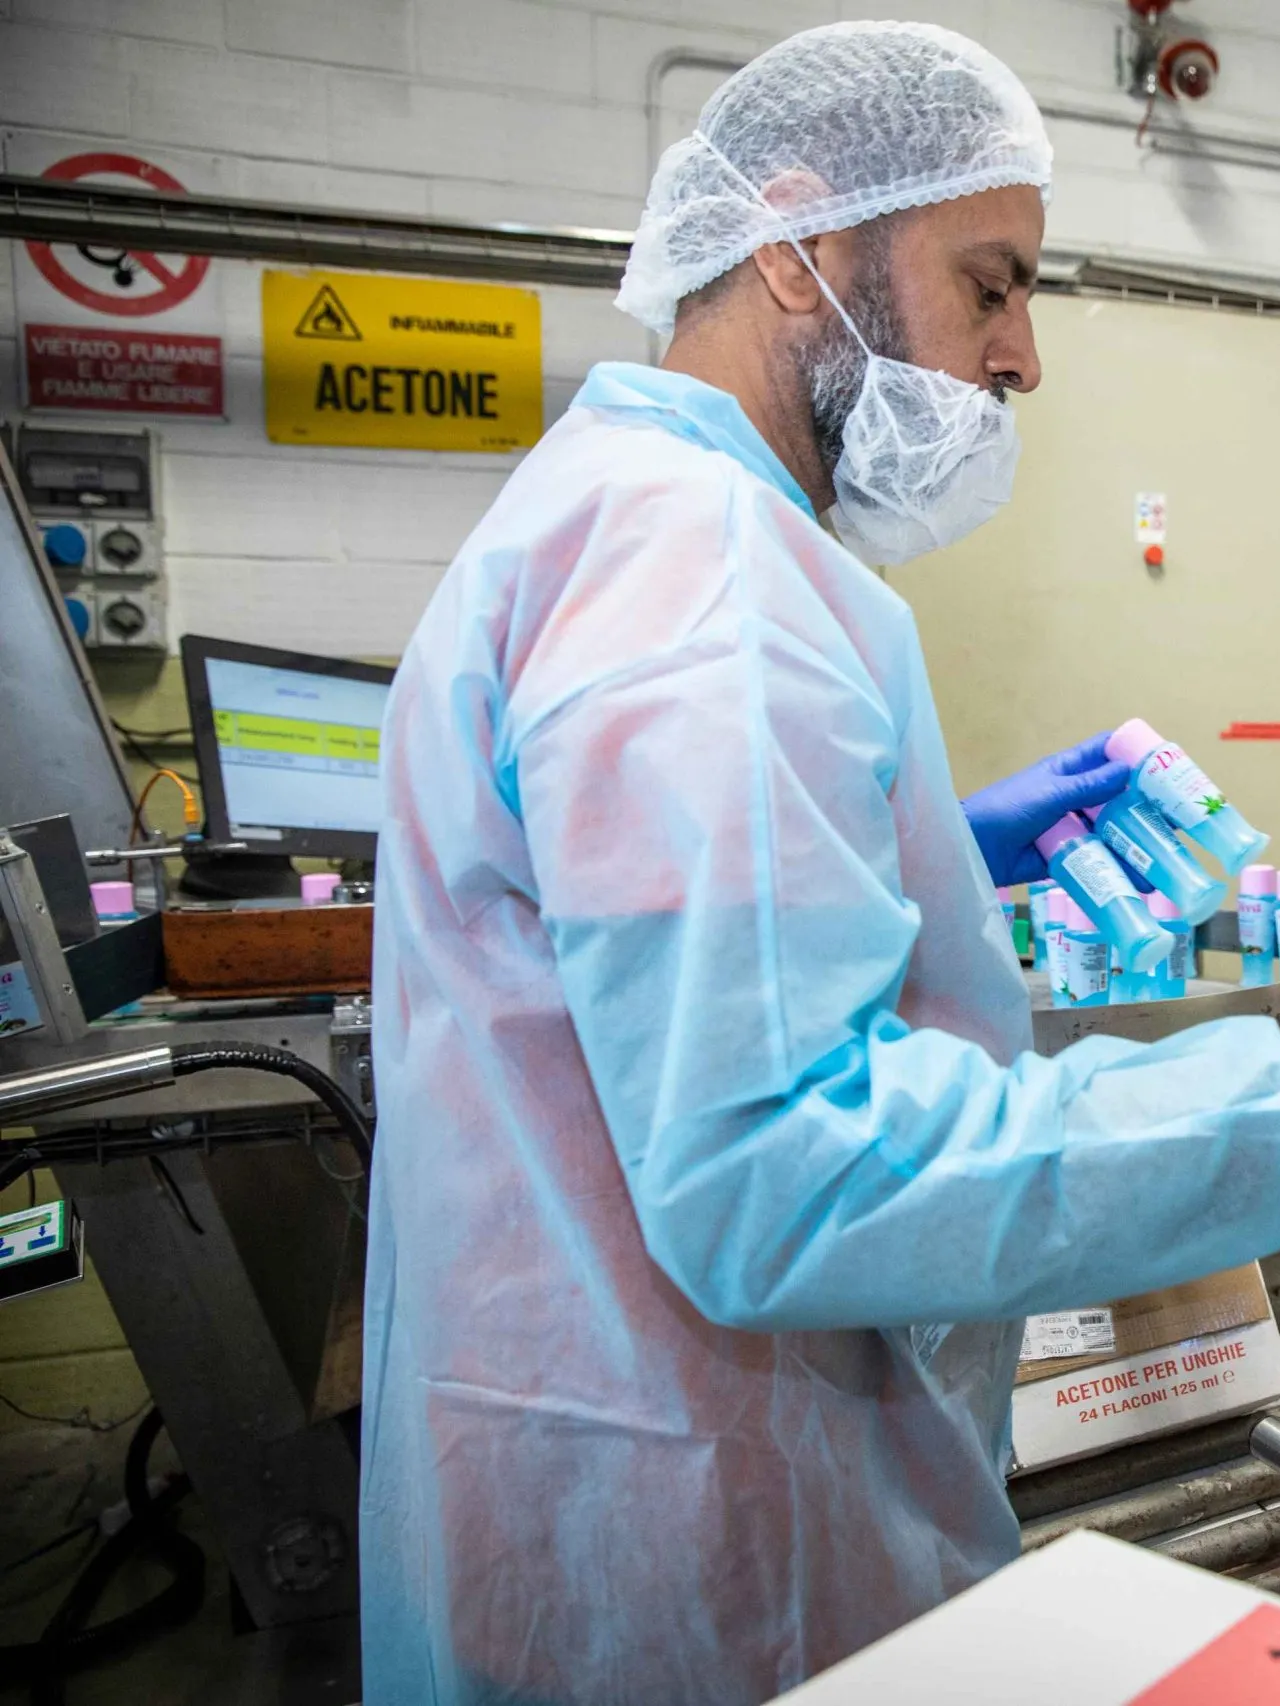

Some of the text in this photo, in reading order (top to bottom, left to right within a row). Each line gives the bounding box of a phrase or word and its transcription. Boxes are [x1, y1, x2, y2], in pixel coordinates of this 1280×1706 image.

[31, 336, 216, 365] VIETATO FUMARE
[77, 360, 176, 383] E USARE
[315, 362, 499, 420] ACETONE
[42, 379, 213, 406] FIAMME LIBERE
[1056, 1342, 1247, 1407] ACETONE PER UNGHIE
[1079, 1409, 1098, 1423] 24
[1102, 1389, 1168, 1416] FLACONI
[1171, 1381, 1197, 1397] 125
[1201, 1374, 1219, 1389] ml
